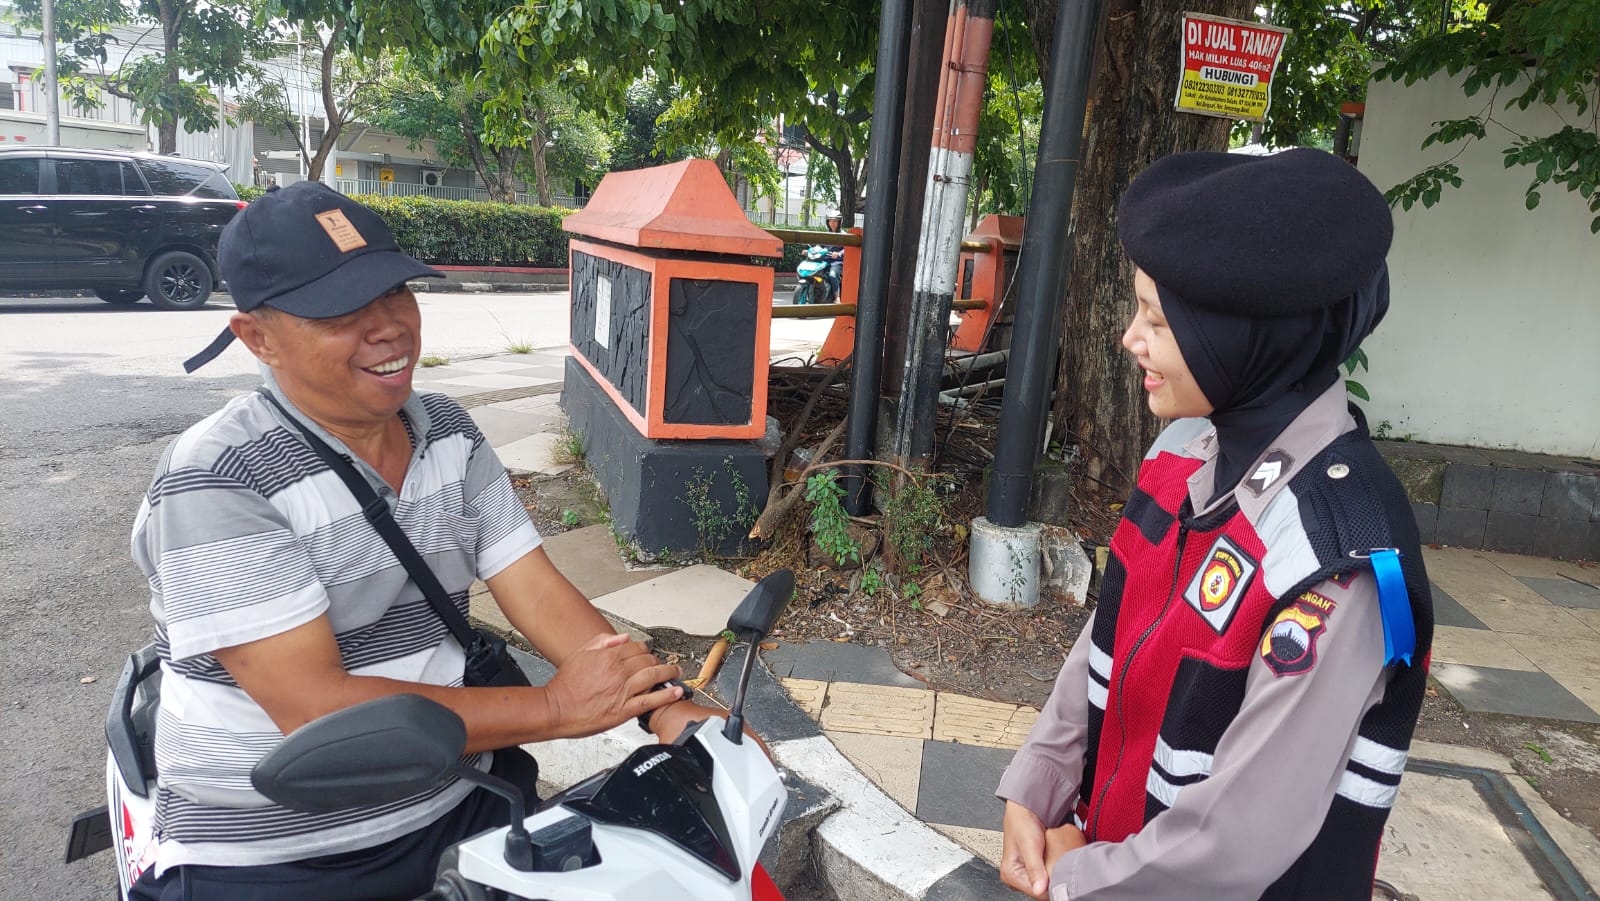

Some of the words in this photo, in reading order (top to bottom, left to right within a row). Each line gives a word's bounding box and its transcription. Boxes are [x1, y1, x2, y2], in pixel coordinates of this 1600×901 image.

[1188, 21, 1202, 46] DI
[1204, 25, 1237, 52] JUAL
[1240, 30, 1280, 59] TANAH
[1188, 50, 1205, 62] HAK
[1205, 53, 1229, 65] MILIK
[1230, 56, 1248, 68] LUAS
[1205, 68, 1254, 86] HUBUNGI
[1300, 591, 1332, 611] ENGAH
[632, 751, 672, 777] HONDA
